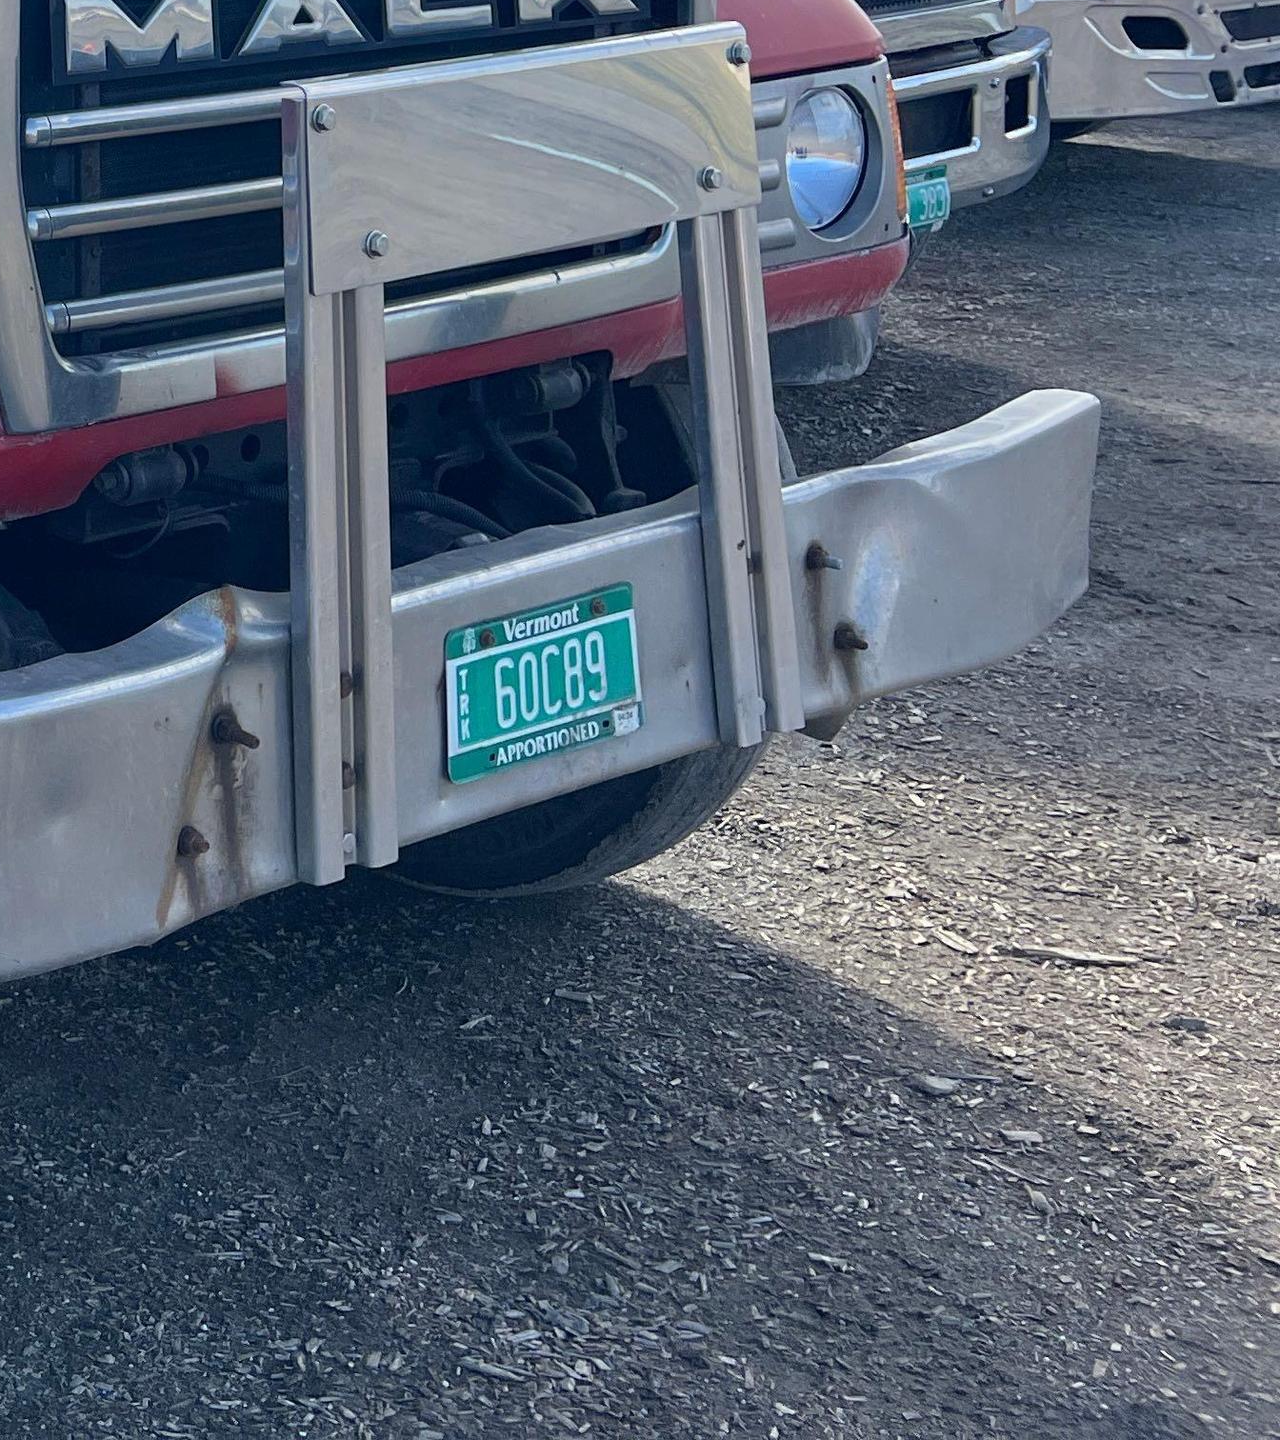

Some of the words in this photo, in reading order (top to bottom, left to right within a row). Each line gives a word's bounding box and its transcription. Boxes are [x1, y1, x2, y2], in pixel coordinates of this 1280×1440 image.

[503, 603, 580, 642] Vermont
[458, 668, 471, 741] TRK
[494, 630, 609, 729] 60C89
[495, 720, 600, 766] APPORTIONED
